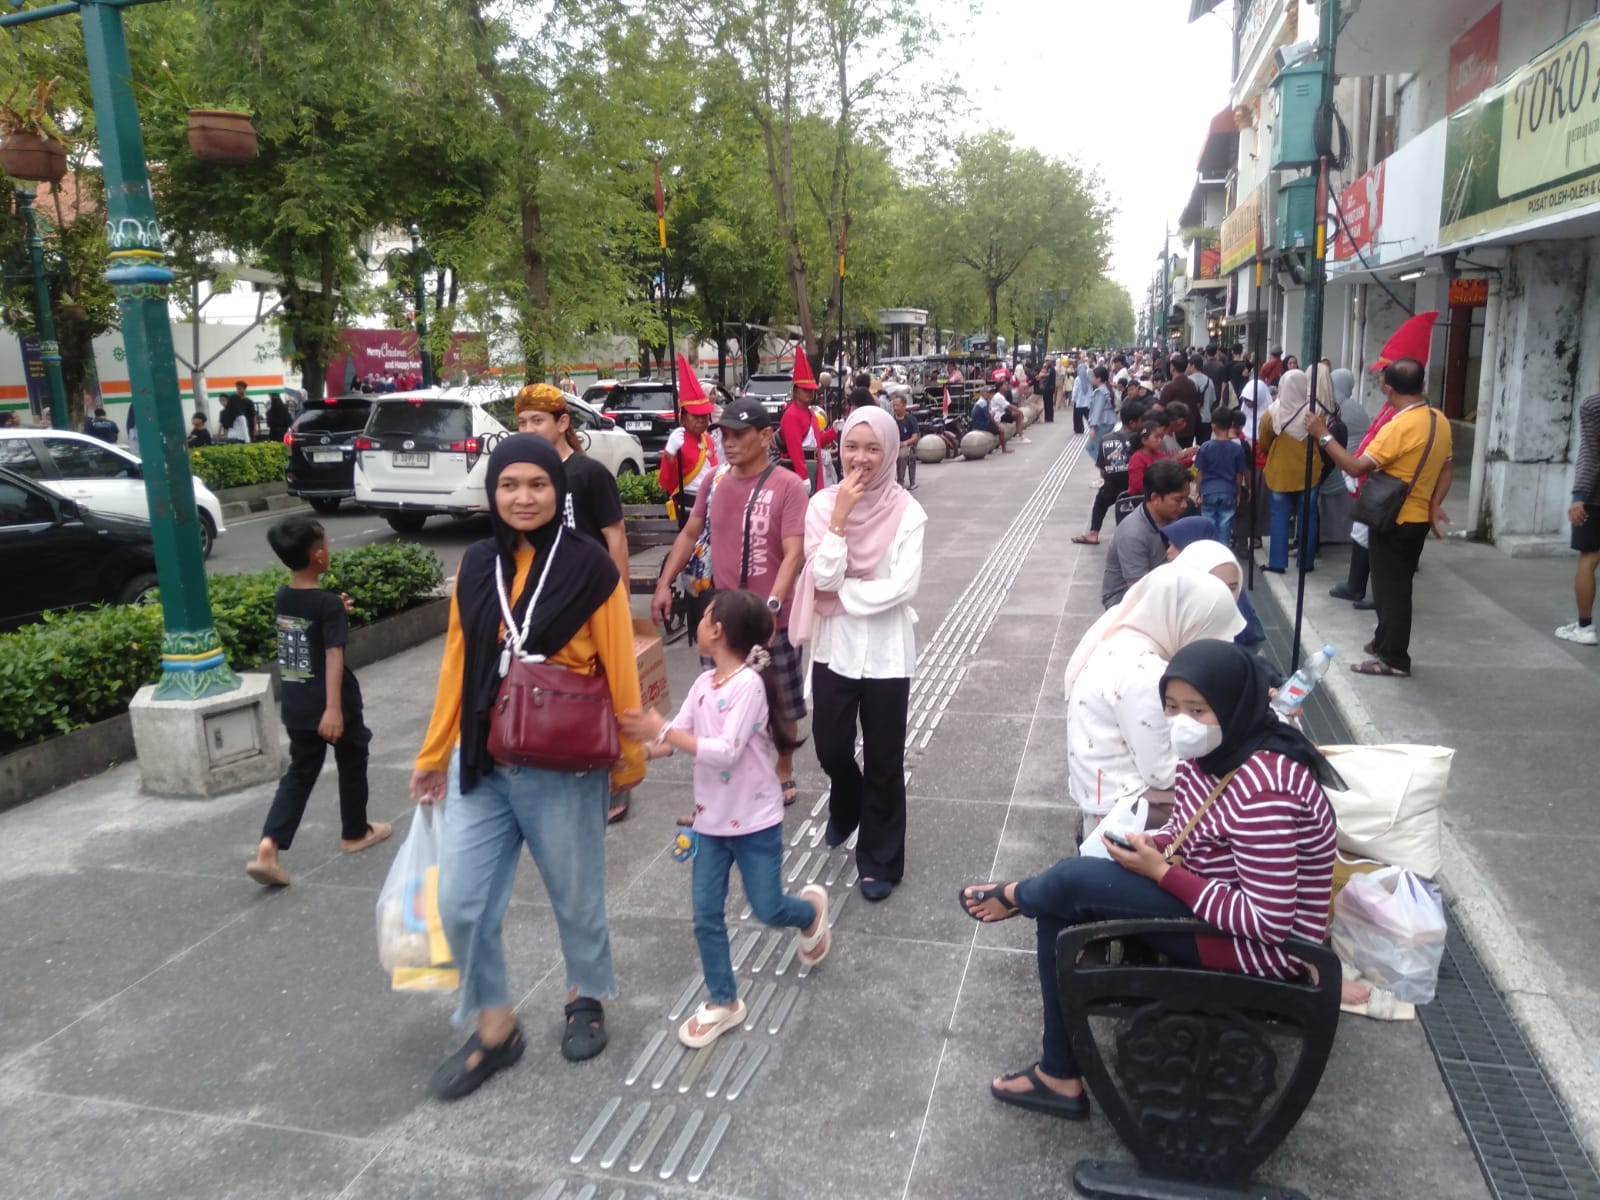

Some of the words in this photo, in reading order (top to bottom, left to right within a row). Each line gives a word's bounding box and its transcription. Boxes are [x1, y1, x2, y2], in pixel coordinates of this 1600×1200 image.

[1514, 40, 1590, 140] TOKO
[1528, 195, 1548, 215] PUSAT
[1549, 183, 1589, 208] OLEH-OLEH
[366, 347, 381, 358] Merry
[380, 342, 408, 358] Christmas
[384, 360, 394, 369] and
[395, 360, 409, 370] Happy
